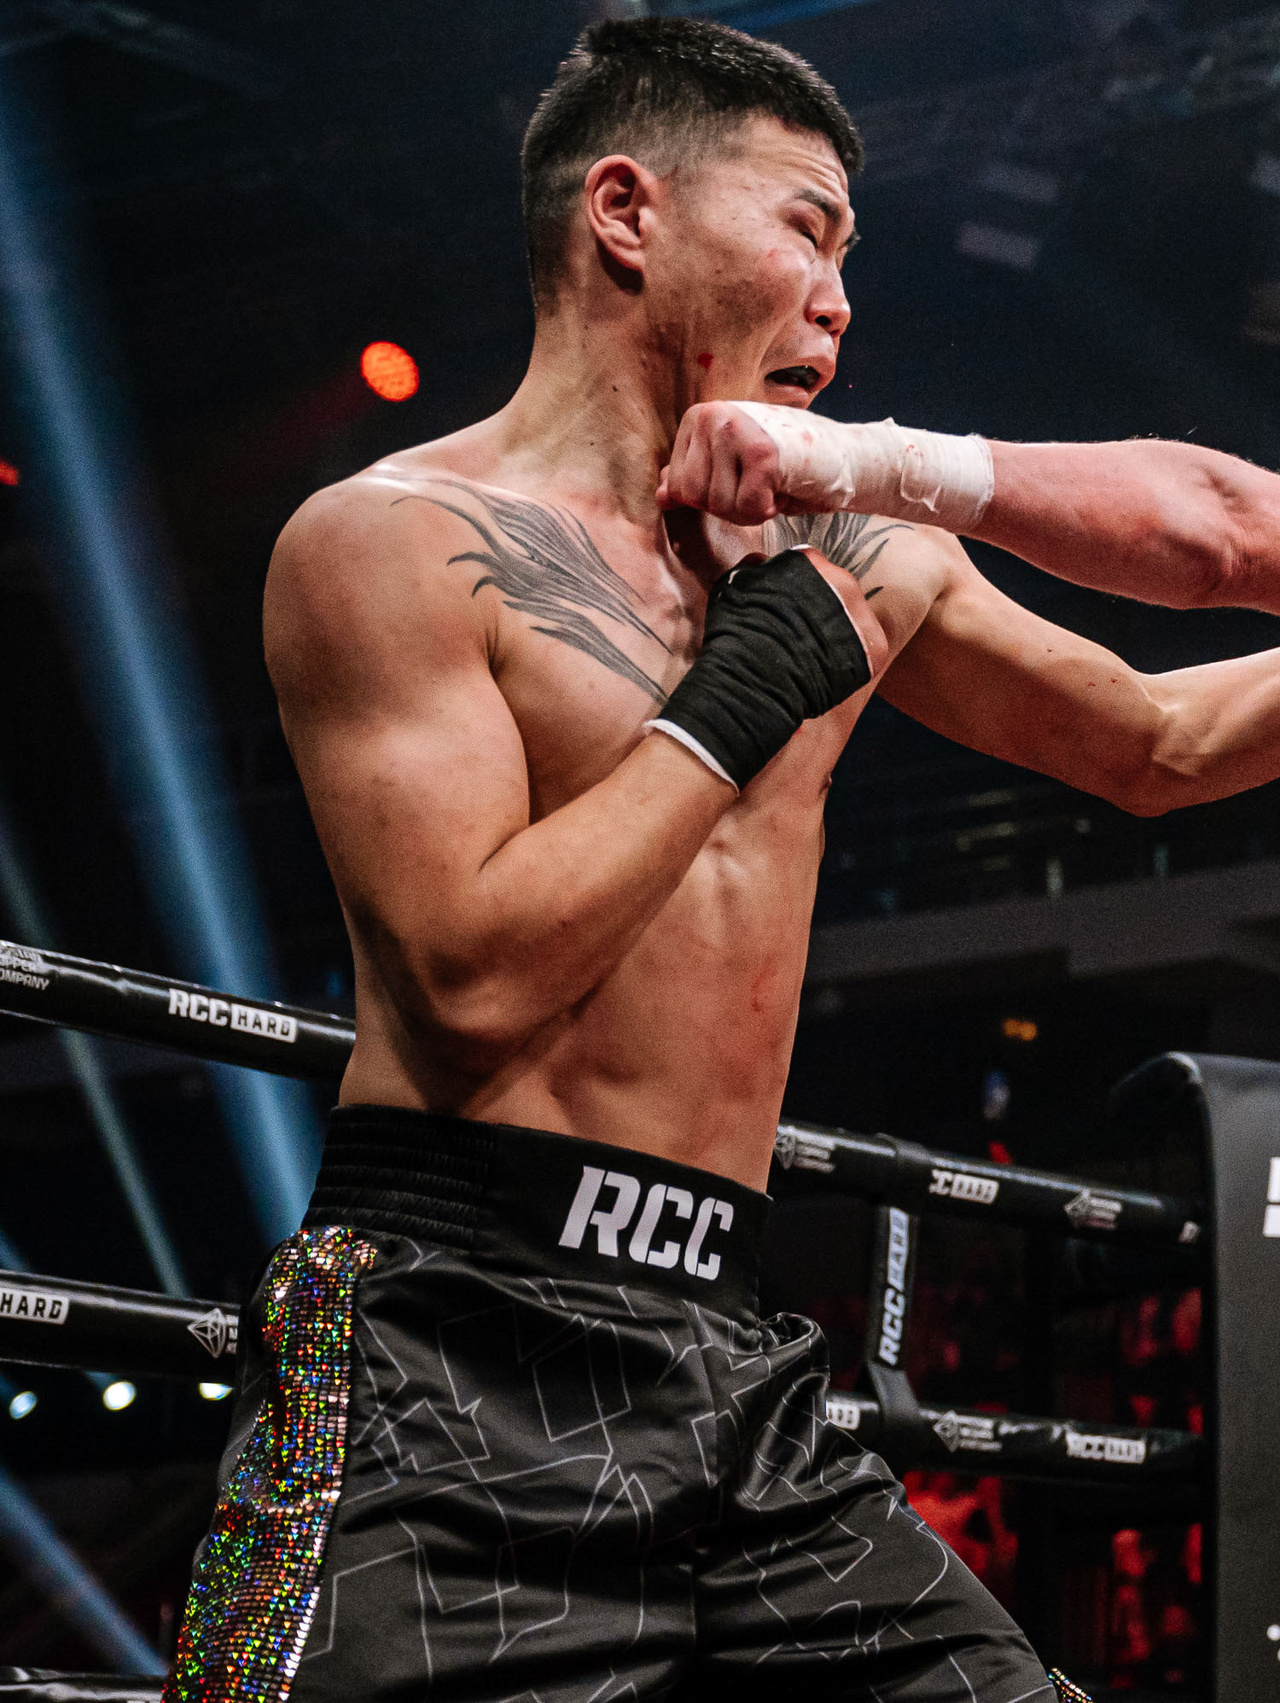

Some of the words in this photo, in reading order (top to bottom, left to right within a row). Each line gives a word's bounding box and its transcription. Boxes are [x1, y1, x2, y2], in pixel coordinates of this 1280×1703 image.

[168, 988, 231, 1027] RCC
[237, 1009, 291, 1037] HARD
[558, 1165, 734, 1281] RCC
[0, 1291, 63, 1321] HARD
[879, 1287, 906, 1366] RCC
